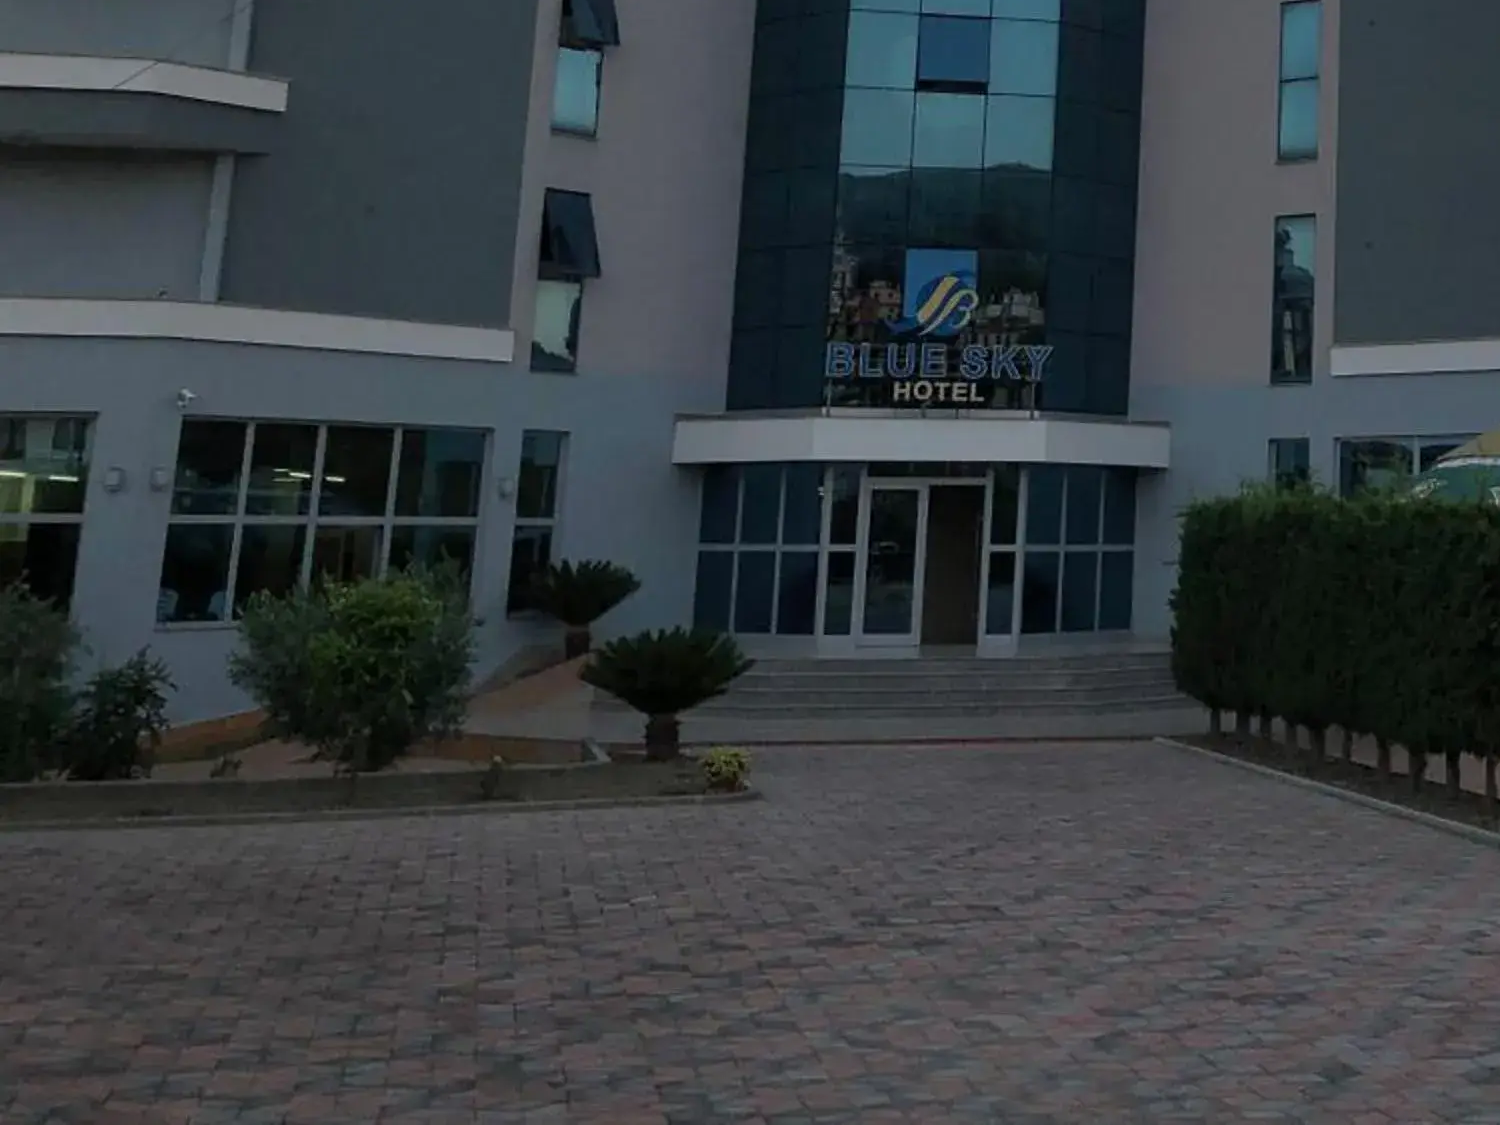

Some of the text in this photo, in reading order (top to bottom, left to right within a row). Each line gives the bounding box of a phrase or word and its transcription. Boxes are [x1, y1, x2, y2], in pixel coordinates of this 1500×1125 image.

[825, 342, 1054, 380] BLUE SKY
[893, 380, 985, 403] HOTEL
